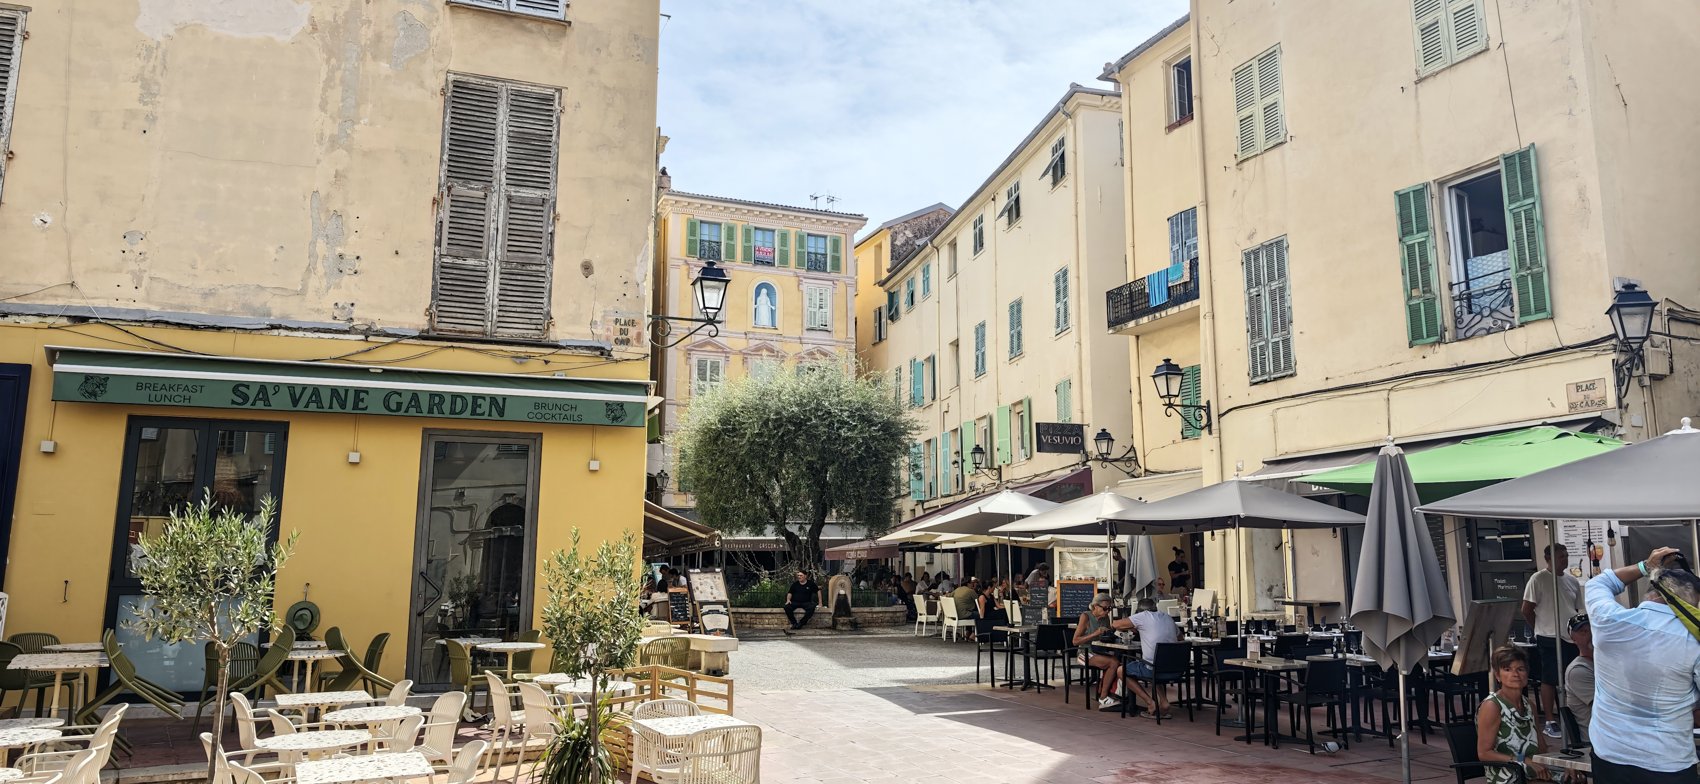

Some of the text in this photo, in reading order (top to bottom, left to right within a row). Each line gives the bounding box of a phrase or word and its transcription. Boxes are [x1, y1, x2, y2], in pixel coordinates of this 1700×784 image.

[614, 318, 636, 327] PLACE
[620, 327, 629, 336] DU
[135, 382, 205, 394] BREAKFAST
[1576, 383, 1596, 393] PLACE
[148, 393, 192, 404] LUNCH
[382, 390, 507, 418] GARDEN
[533, 401, 578, 412] BRUNCH
[526, 411, 583, 422] COCKTAILS
[1040, 424, 1082, 435] PIZZA
[1041, 435, 1082, 445] VESUVIO
